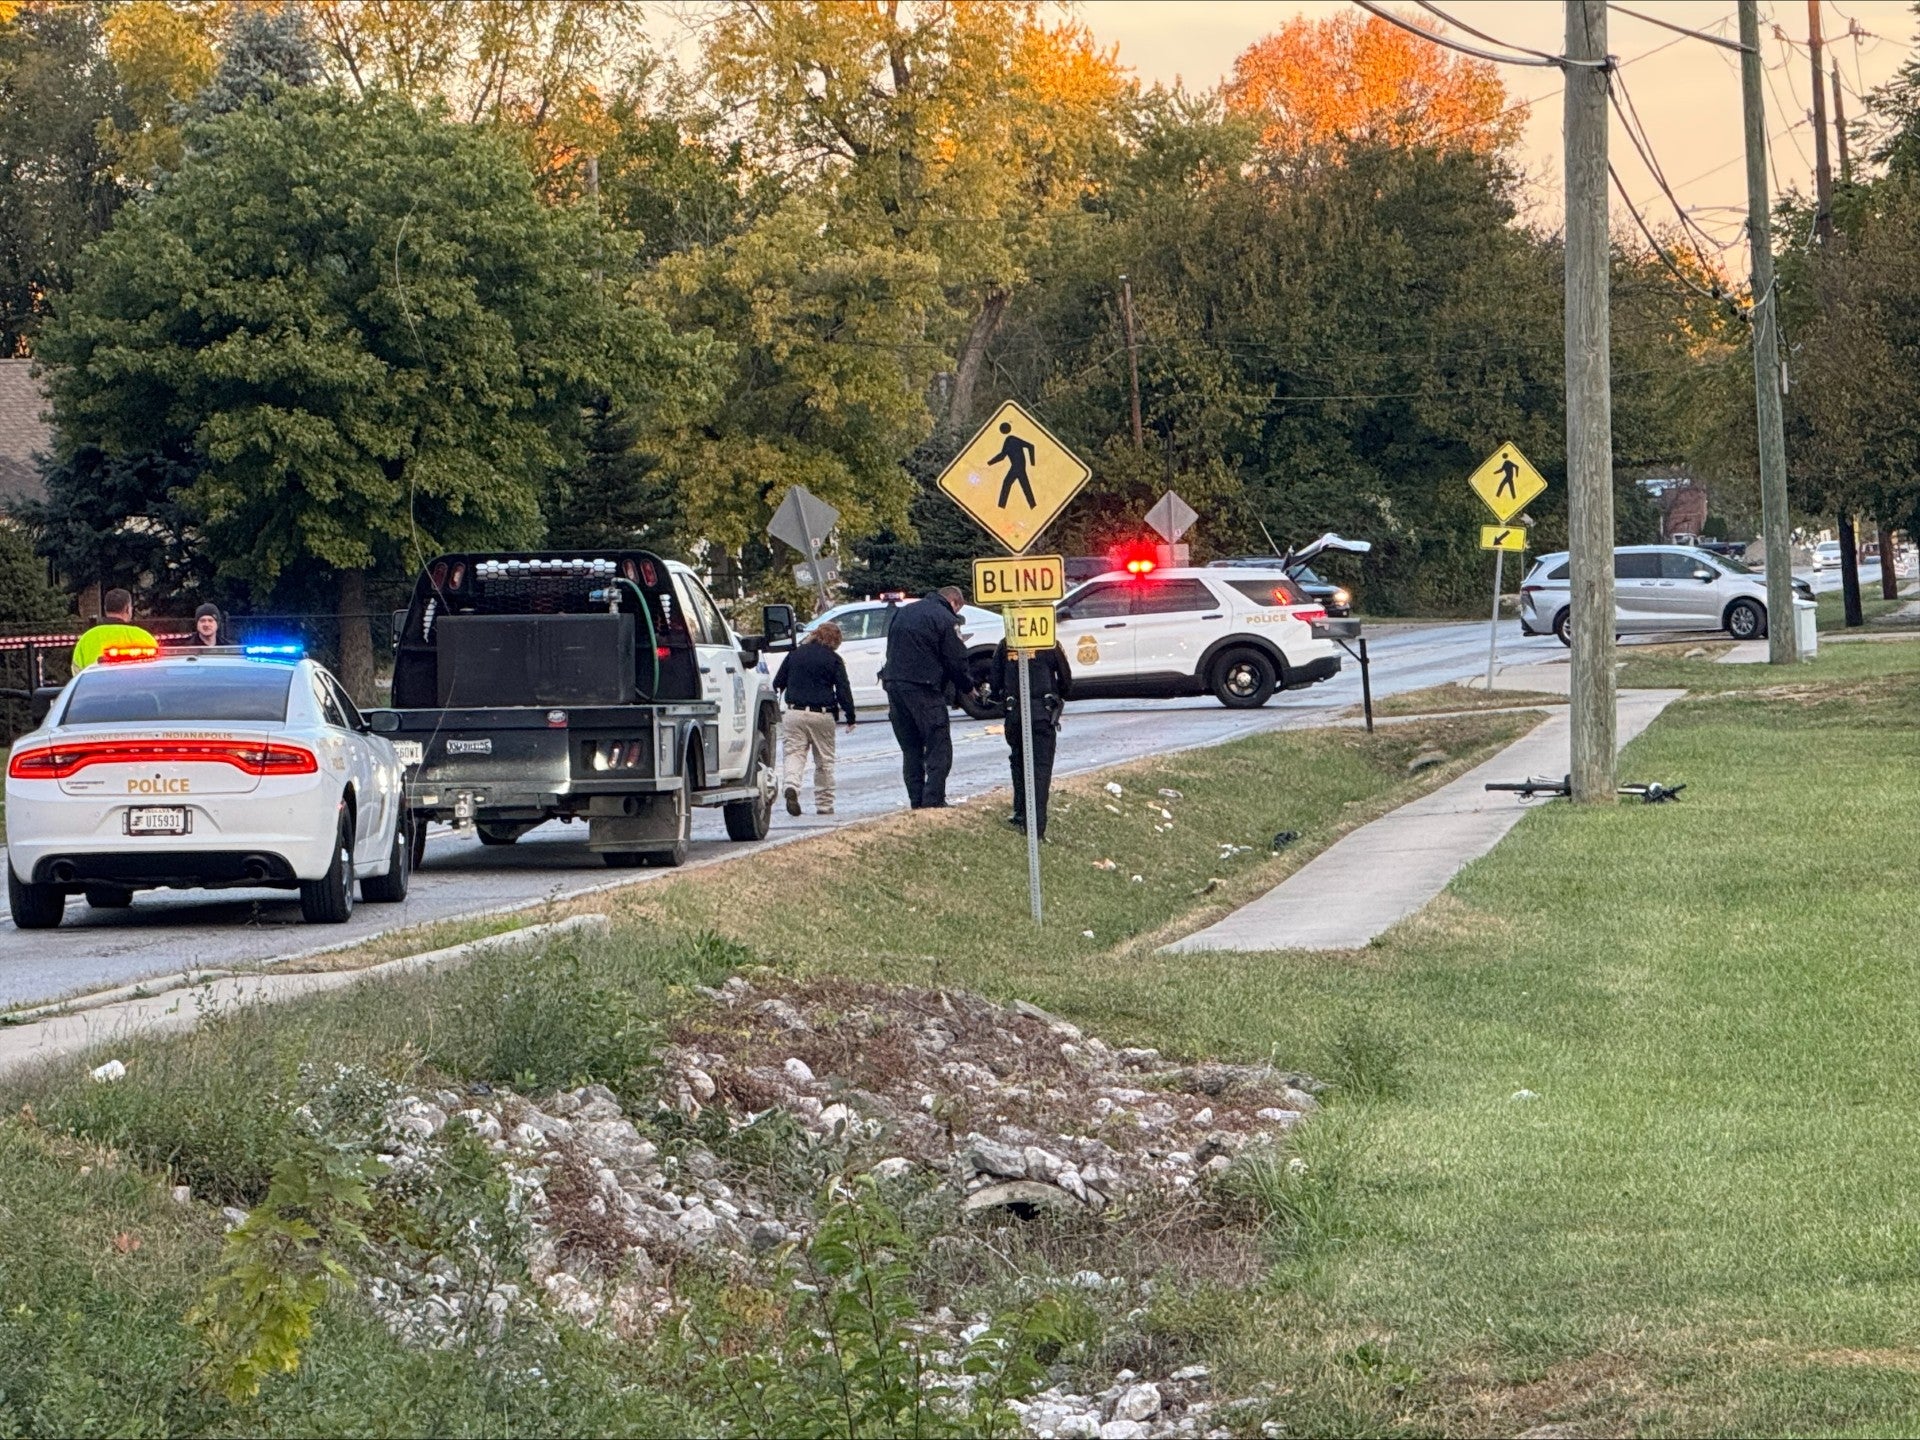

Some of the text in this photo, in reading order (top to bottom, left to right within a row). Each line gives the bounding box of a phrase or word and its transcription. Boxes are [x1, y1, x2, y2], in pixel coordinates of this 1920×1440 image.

[982, 567, 1054, 594] BLIND
[1246, 613, 1288, 624] POLICE
[1007, 616, 1049, 638] HEAD
[162, 731, 233, 740] INDIANAPOLIS
[127, 778, 190, 793] POLICE
[146, 814, 181, 827] UI5931
